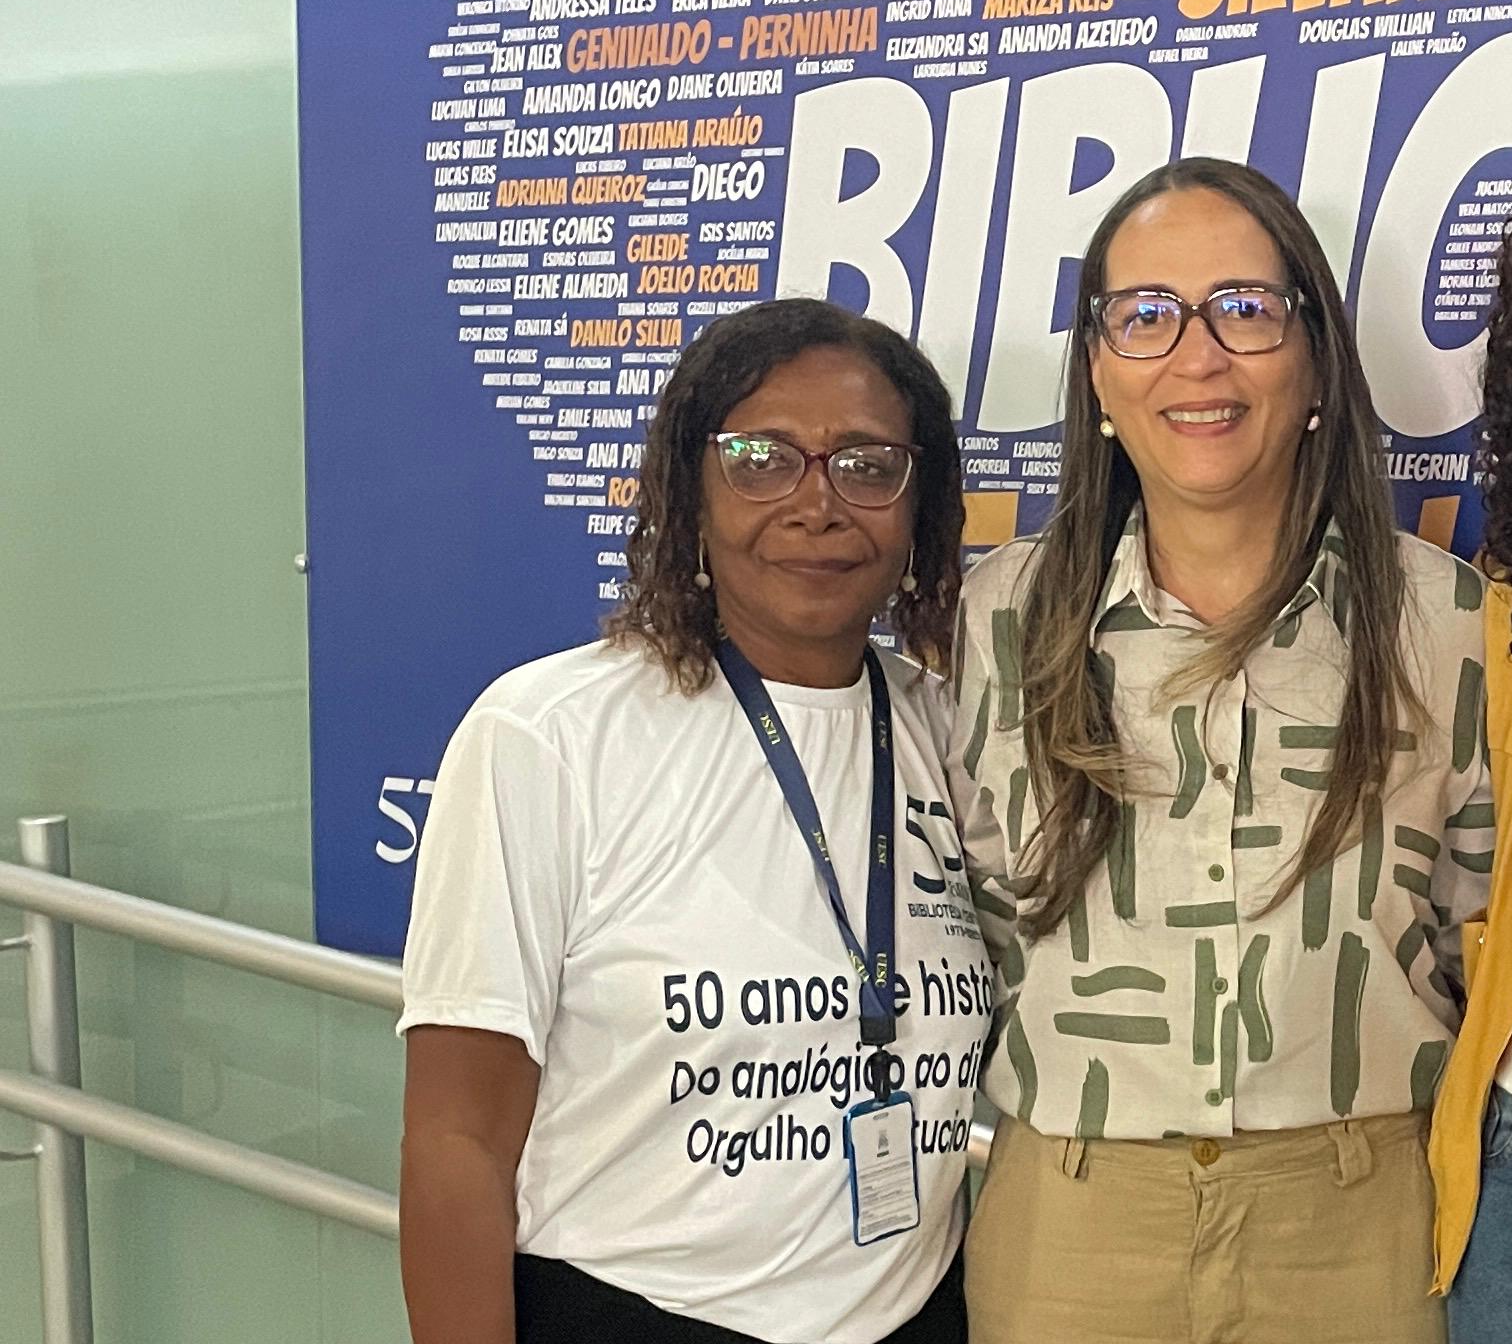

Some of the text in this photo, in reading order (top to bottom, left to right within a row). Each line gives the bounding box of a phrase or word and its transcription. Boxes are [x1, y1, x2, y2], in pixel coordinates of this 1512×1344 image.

[567, 19, 712, 74] GENIVALDO
[740, 6, 879, 60] PERNINHA
[1299, 11, 1435, 44] DOUGLAS WILLIAN
[522, 78, 661, 115] AMANDA LONGO
[618, 104, 763, 151] TATIANA ARAÚJO
[496, 177, 569, 208] ADRIANA
[572, 173, 647, 203] QUEIROZ
[692, 161, 765, 201] DIEGO
[636, 263, 759, 294] JOELIO ROCHA
[570, 318, 682, 348] DANILO SILVA
[664, 970, 724, 1033] 50
[741, 975, 849, 1026] anos
[671, 1060, 721, 1105] Do
[915, 1051, 951, 1089] ao
[687, 1114, 831, 1177] Orgulho
